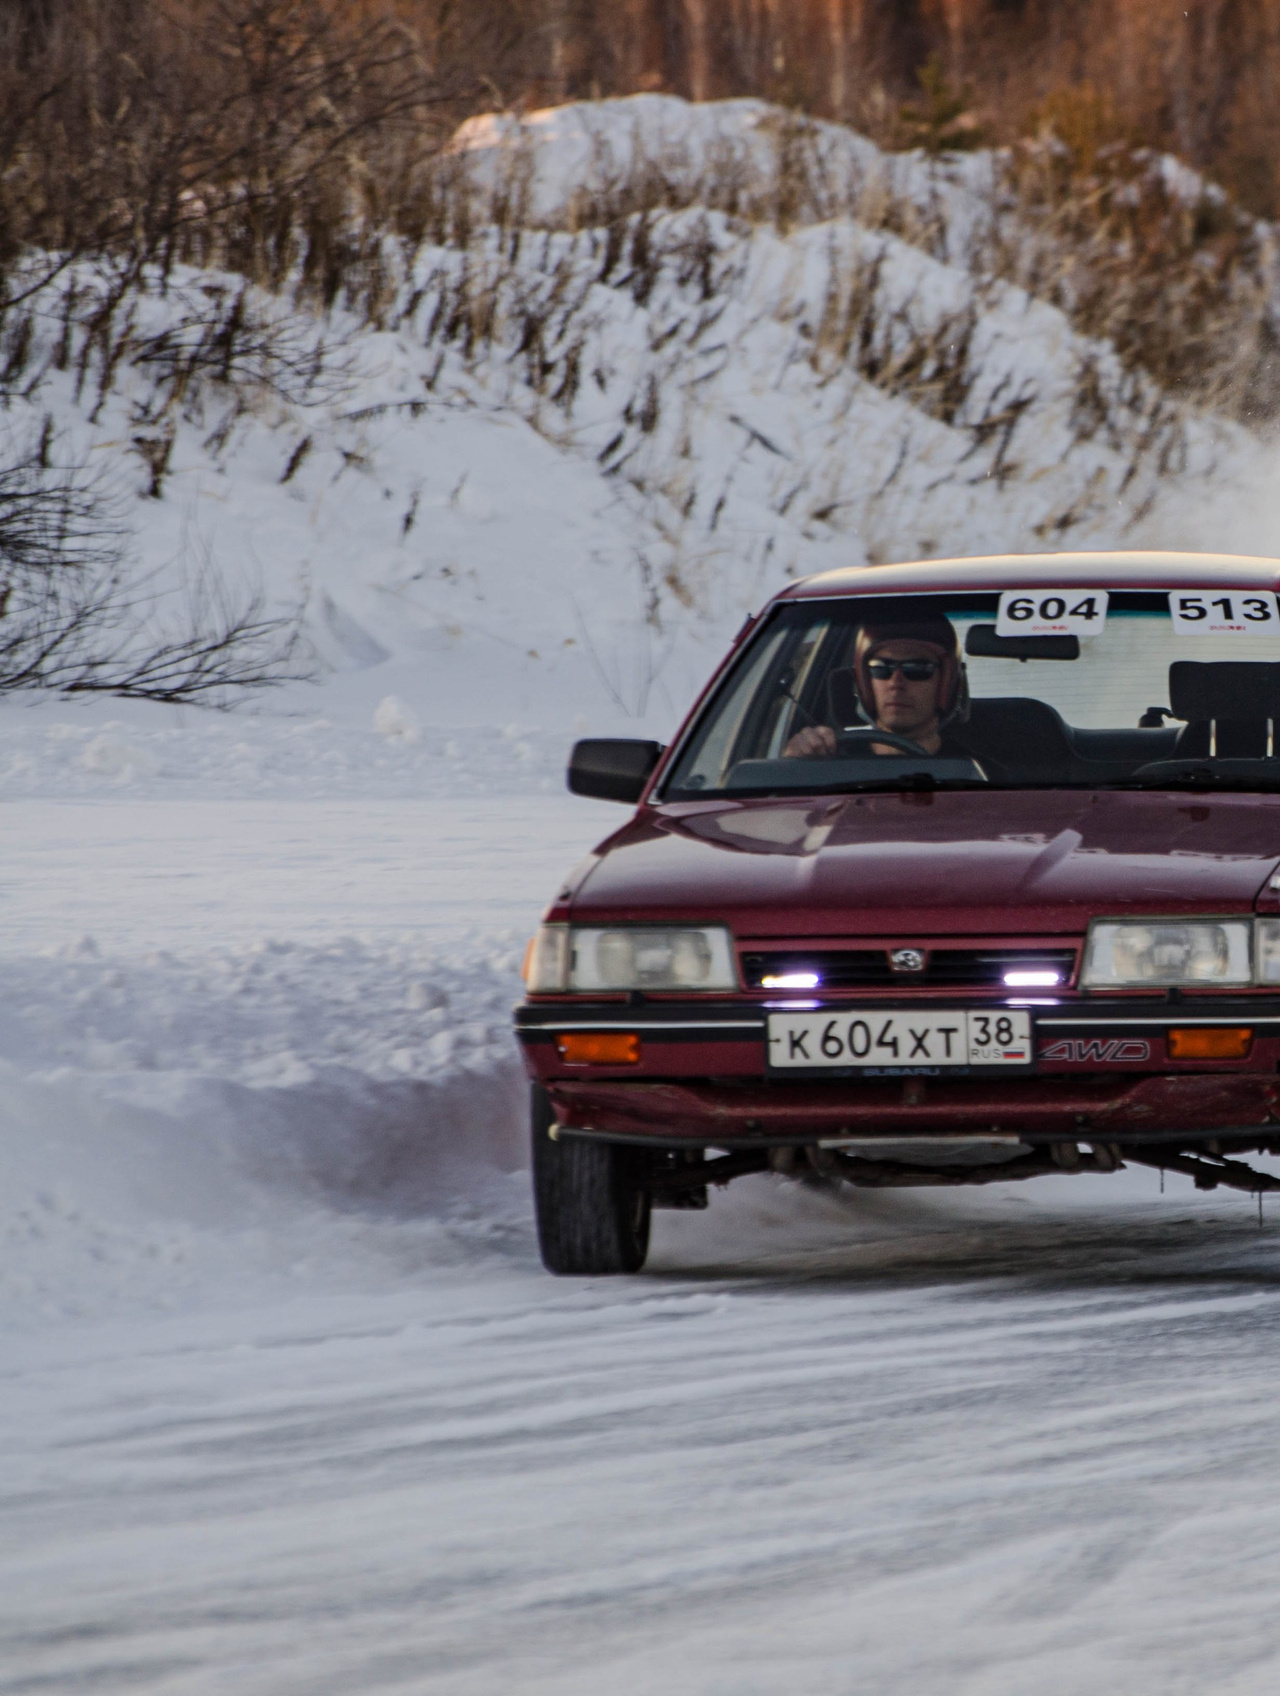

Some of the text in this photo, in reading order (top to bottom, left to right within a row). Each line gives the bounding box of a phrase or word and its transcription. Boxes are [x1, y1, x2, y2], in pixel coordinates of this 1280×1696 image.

[1006, 597, 1099, 621] 604
[1178, 598, 1272, 621] 513
[973, 1016, 1014, 1047] 38
[971, 1048, 1001, 1059] RUS
[1037, 1040, 1150, 1062] AWD
[862, 1067, 940, 1077] SUBARU
